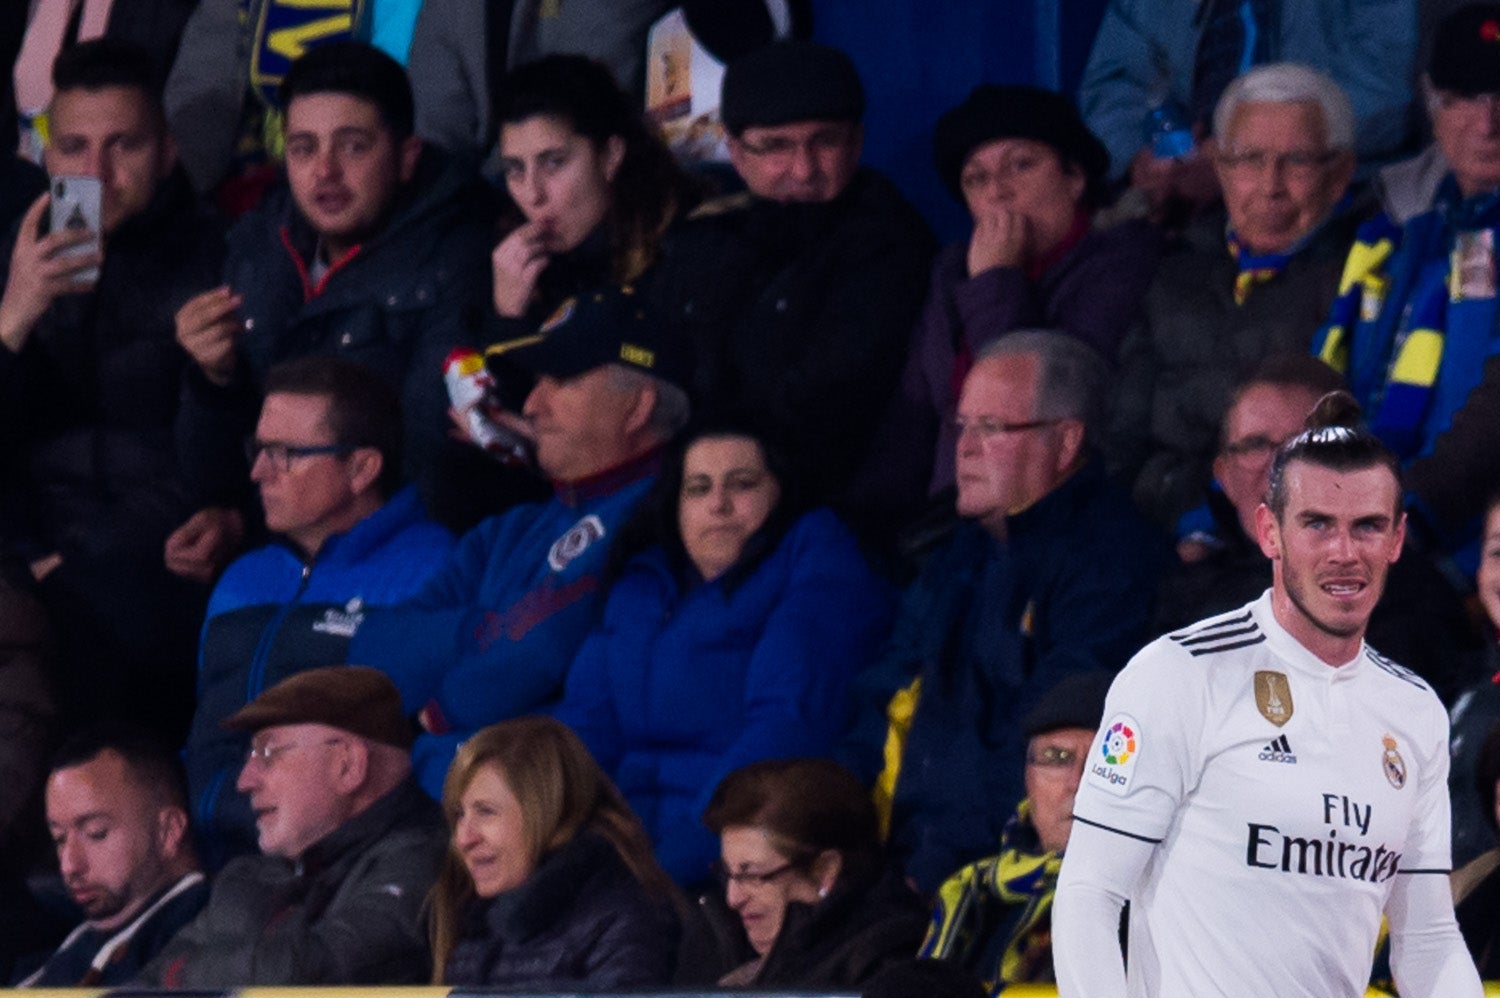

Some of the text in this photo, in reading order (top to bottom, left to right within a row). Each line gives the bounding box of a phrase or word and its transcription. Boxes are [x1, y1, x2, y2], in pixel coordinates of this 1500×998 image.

[1258, 751, 1297, 764] adidas
[1091, 763, 1127, 786] LaLiga
[1322, 793, 1372, 836] Fly
